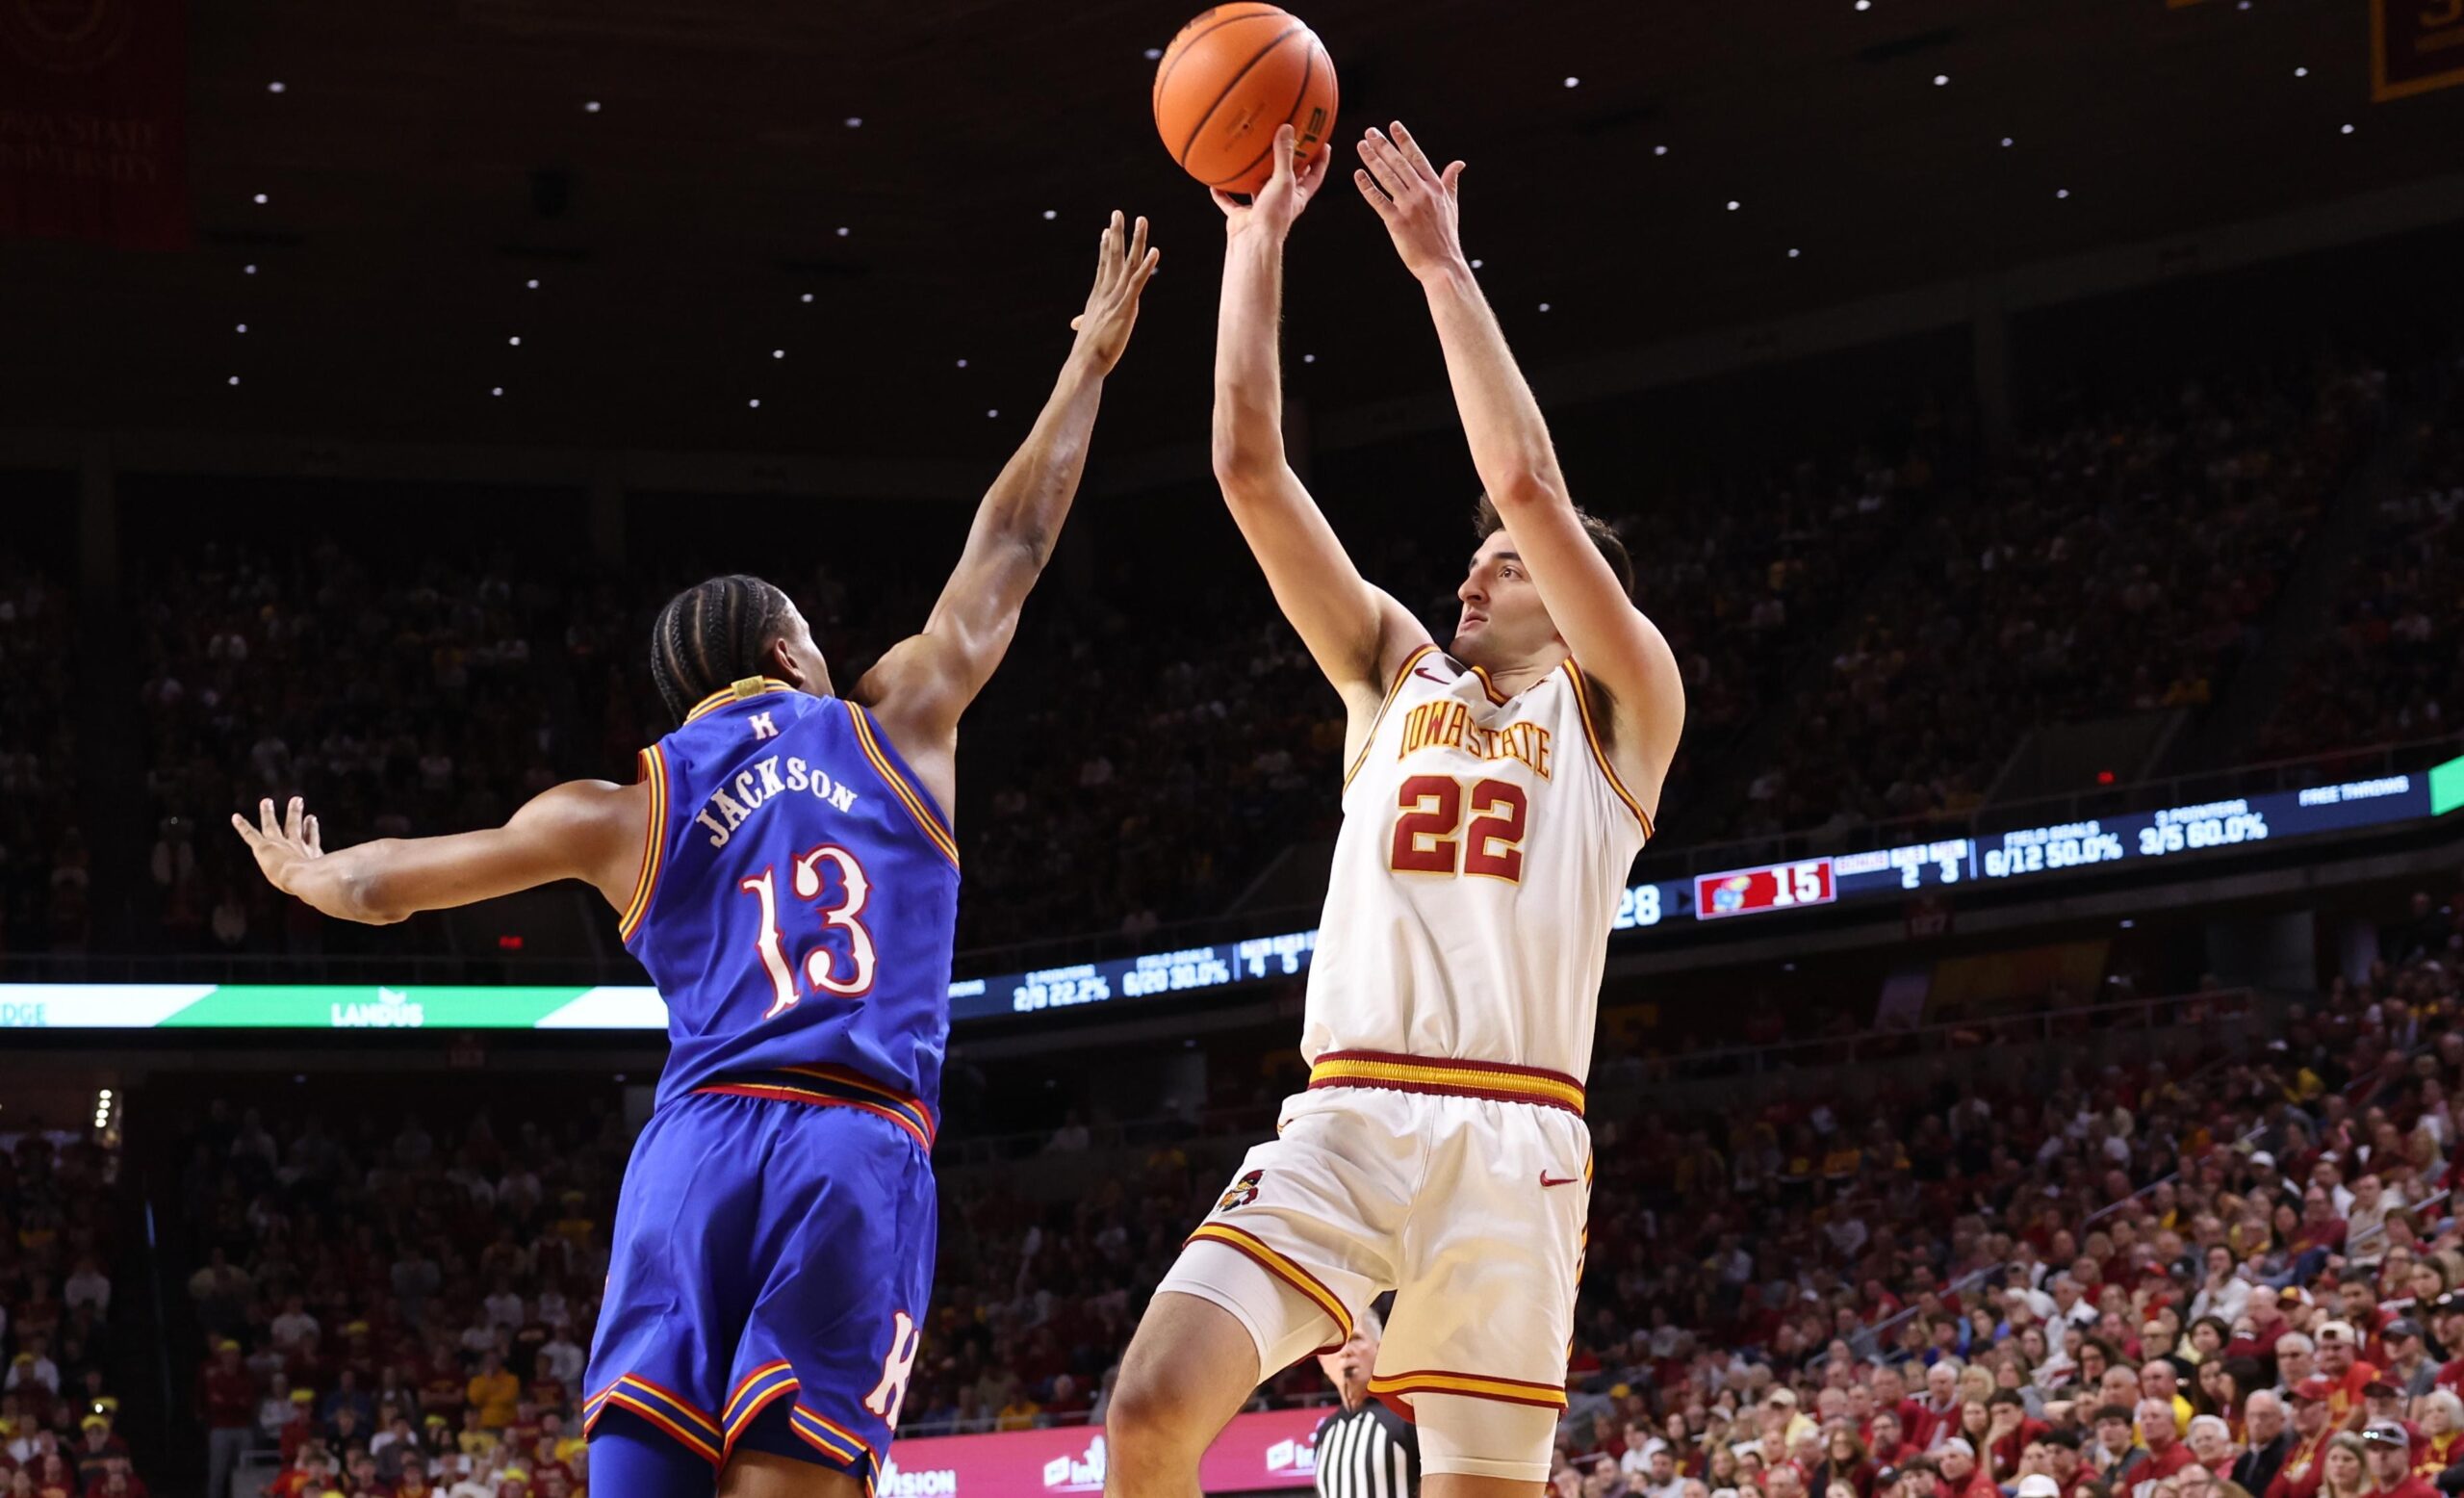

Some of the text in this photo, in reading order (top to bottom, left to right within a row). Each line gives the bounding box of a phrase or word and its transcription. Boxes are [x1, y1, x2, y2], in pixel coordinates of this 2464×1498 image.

[1399, 699, 1553, 783] IOWA STATE
[695, 755, 858, 848] JACKSON
[2299, 786, 2340, 806] FREE
[1391, 774, 1527, 887] 22
[2140, 813, 2268, 855] 3/5 60.0%
[1902, 863, 1919, 889] 2
[1940, 857, 1959, 882] 3
[1985, 844, 2042, 877] 6/12
[2045, 833, 2123, 868] 50.0%
[1772, 862, 1821, 907] 15
[1612, 885, 1660, 930] 28
[739, 843, 878, 1020] 13
[1049, 976, 1110, 1007] 22.2%
[1169, 959, 1230, 990] 30.0%
[331, 1002, 424, 1027] LANDUS
